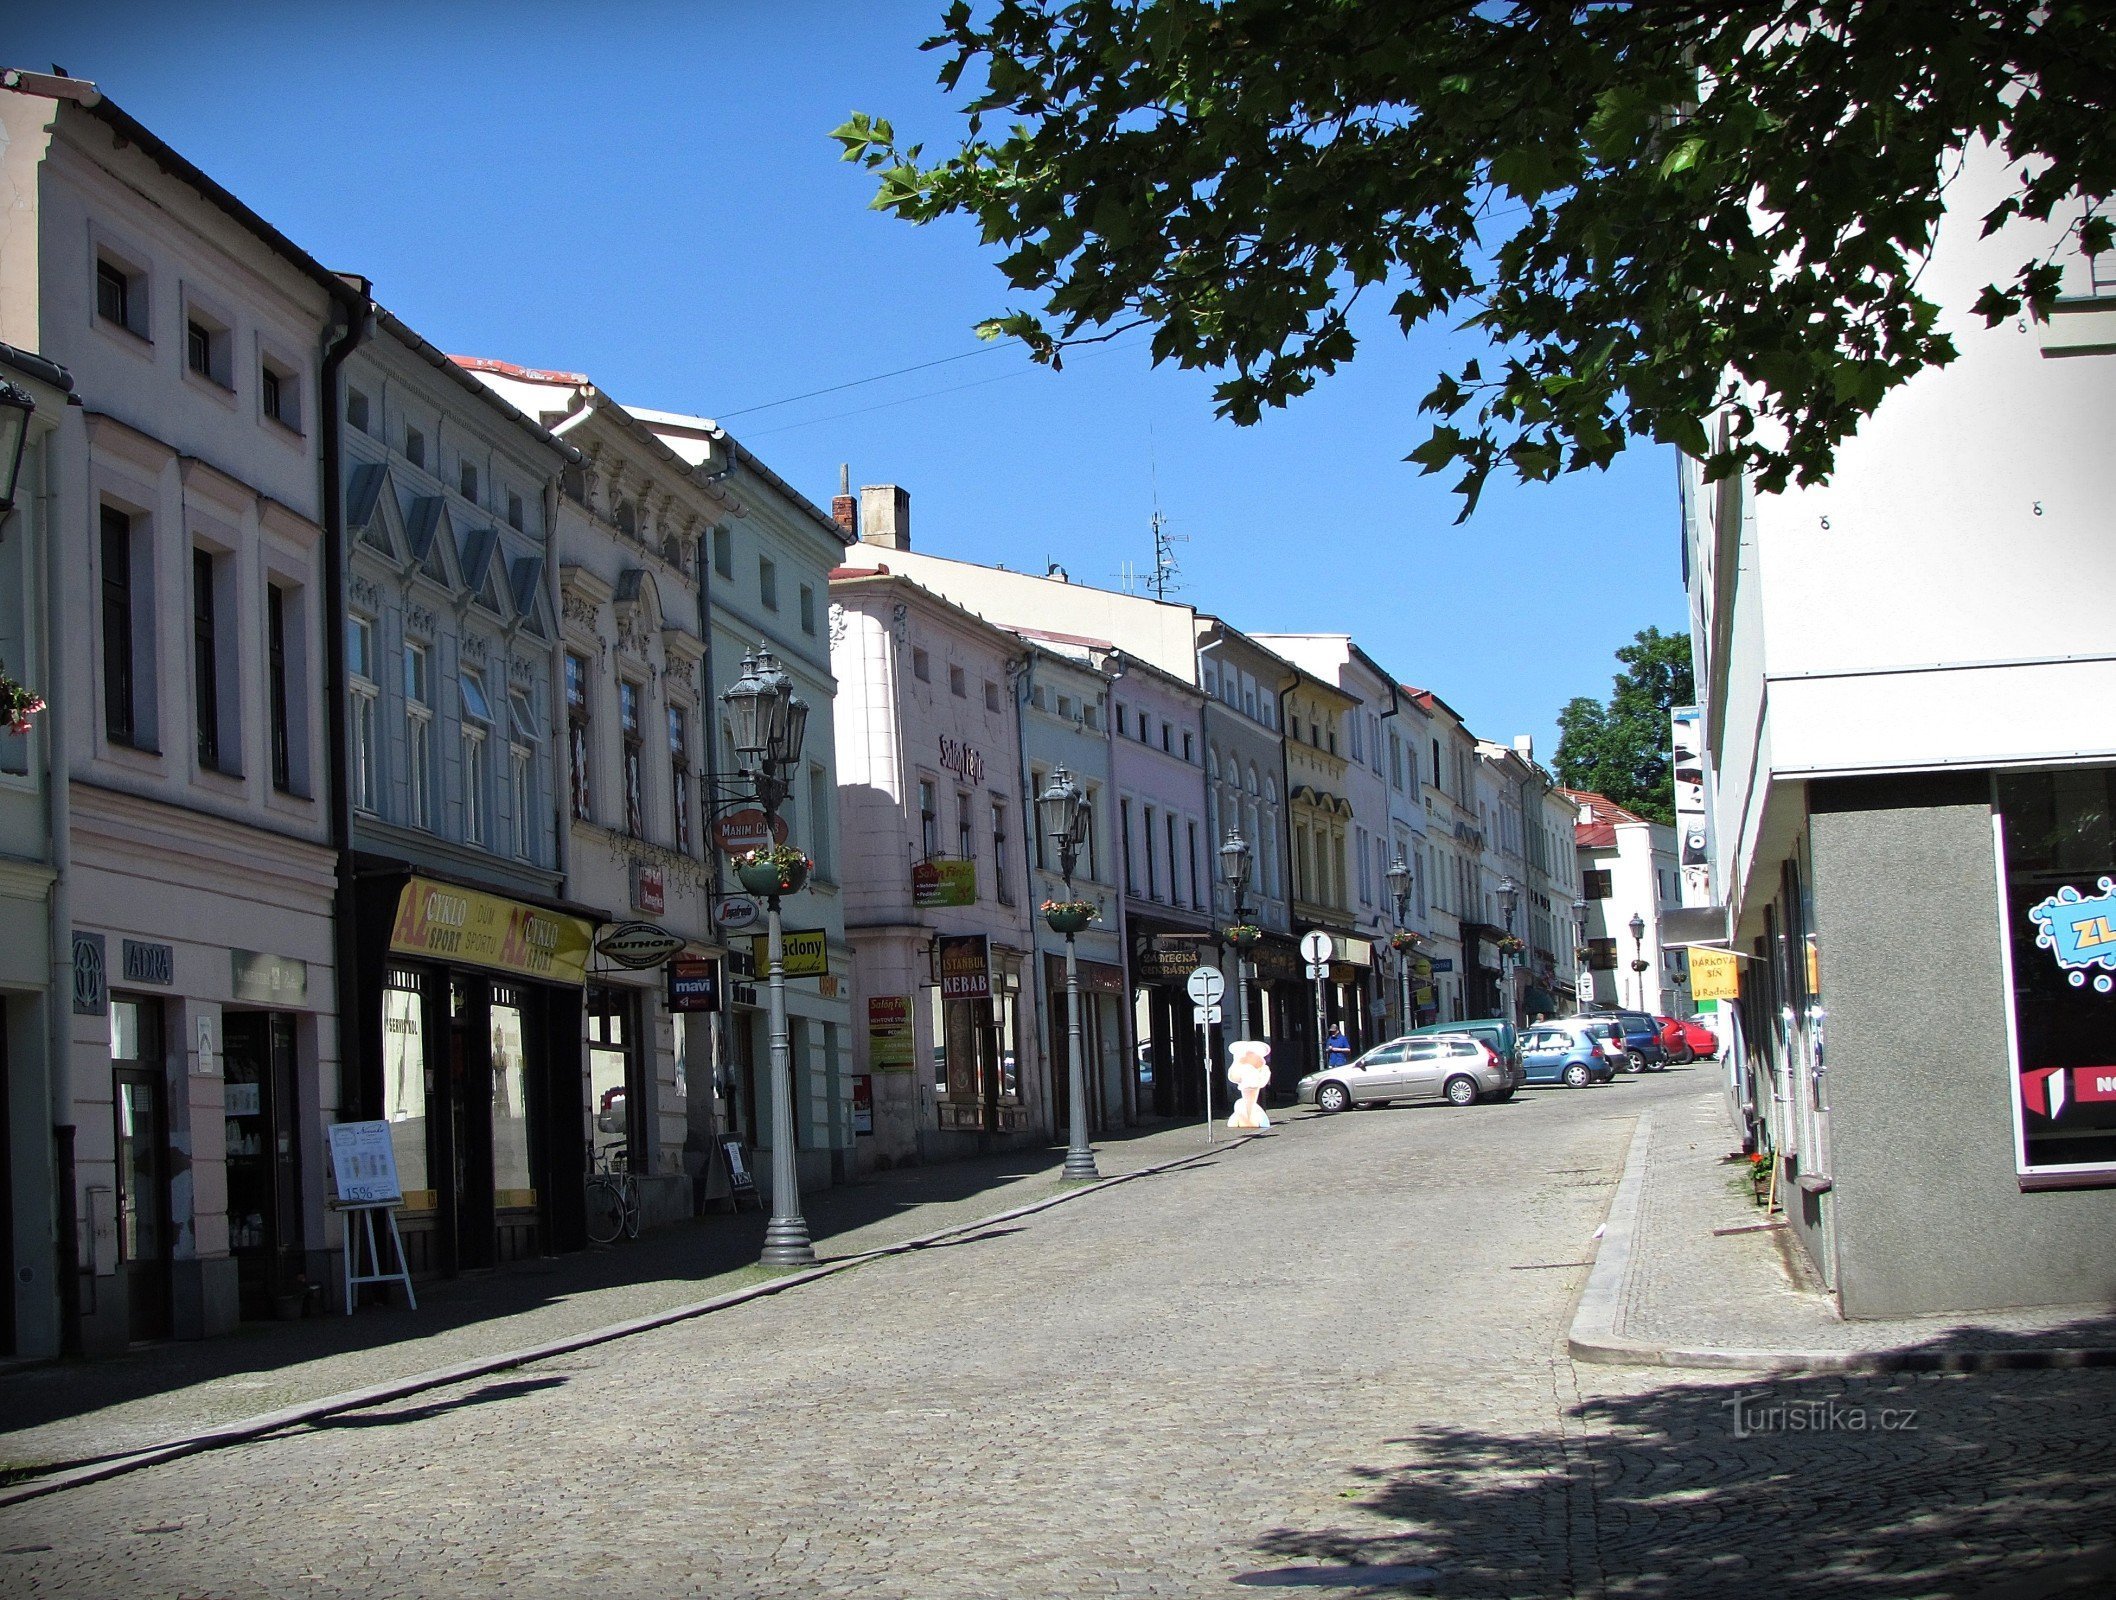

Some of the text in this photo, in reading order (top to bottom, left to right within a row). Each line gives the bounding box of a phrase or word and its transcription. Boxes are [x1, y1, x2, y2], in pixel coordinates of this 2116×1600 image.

[722, 824, 752, 837] MAXIM
[393, 881, 437, 946] AZ
[426, 891, 468, 928] CYKLO
[525, 917, 560, 949] CYKLO
[428, 926, 496, 954] SPORT SPORTU
[605, 940, 675, 950] AUTHOR
[781, 938, 822, 958] áclony
[128, 944, 169, 980] ADRA
[1143, 950, 1198, 963] ZÁMECKÁ
[943, 957, 985, 970] ISTANBUL
[1141, 963, 1197, 975] CUKRÁRN
[675, 979, 711, 992] mavi
[944, 975, 987, 993] KEBAB
[1703, 987, 1737, 997] Radnice
[345, 1187, 373, 1200] 15%
